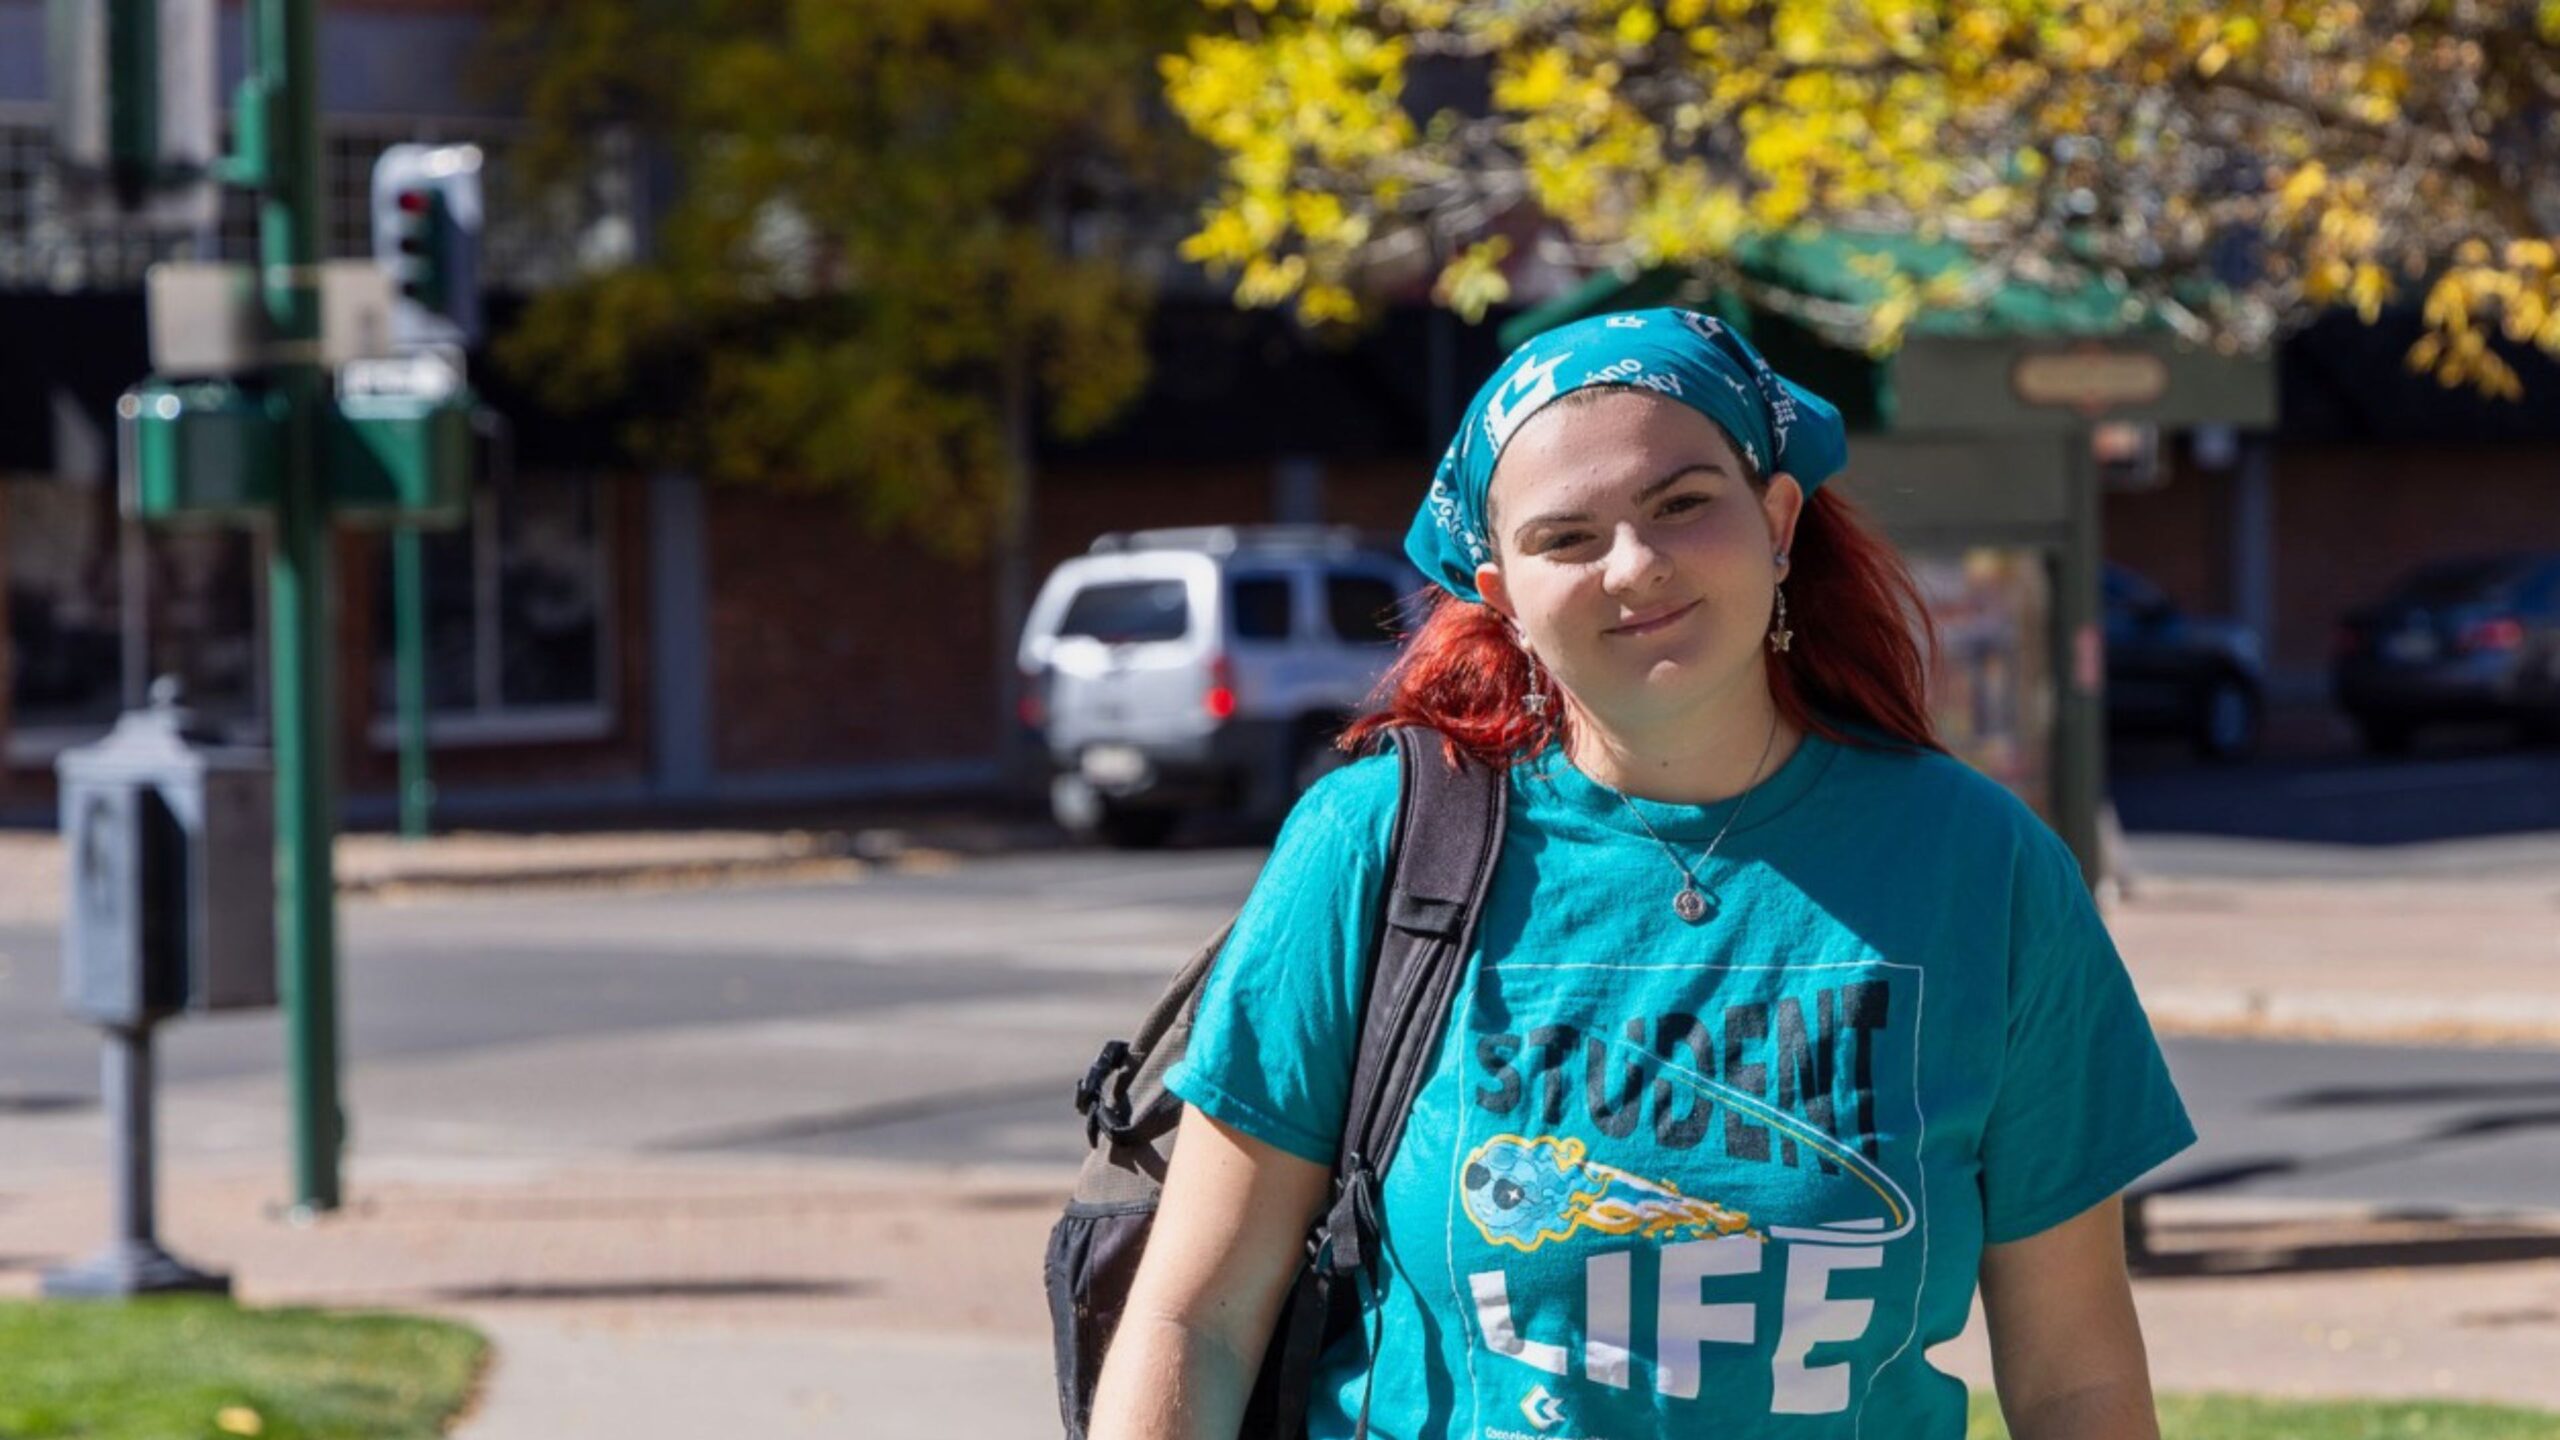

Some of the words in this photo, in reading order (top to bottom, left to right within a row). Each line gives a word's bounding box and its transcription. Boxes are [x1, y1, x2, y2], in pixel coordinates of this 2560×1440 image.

[1583, 359, 1642, 386] ino
[1632, 373, 1684, 397] ity
[1475, 980, 1890, 1176] STUDENT
[1468, 1218, 1884, 1415] LIFE
